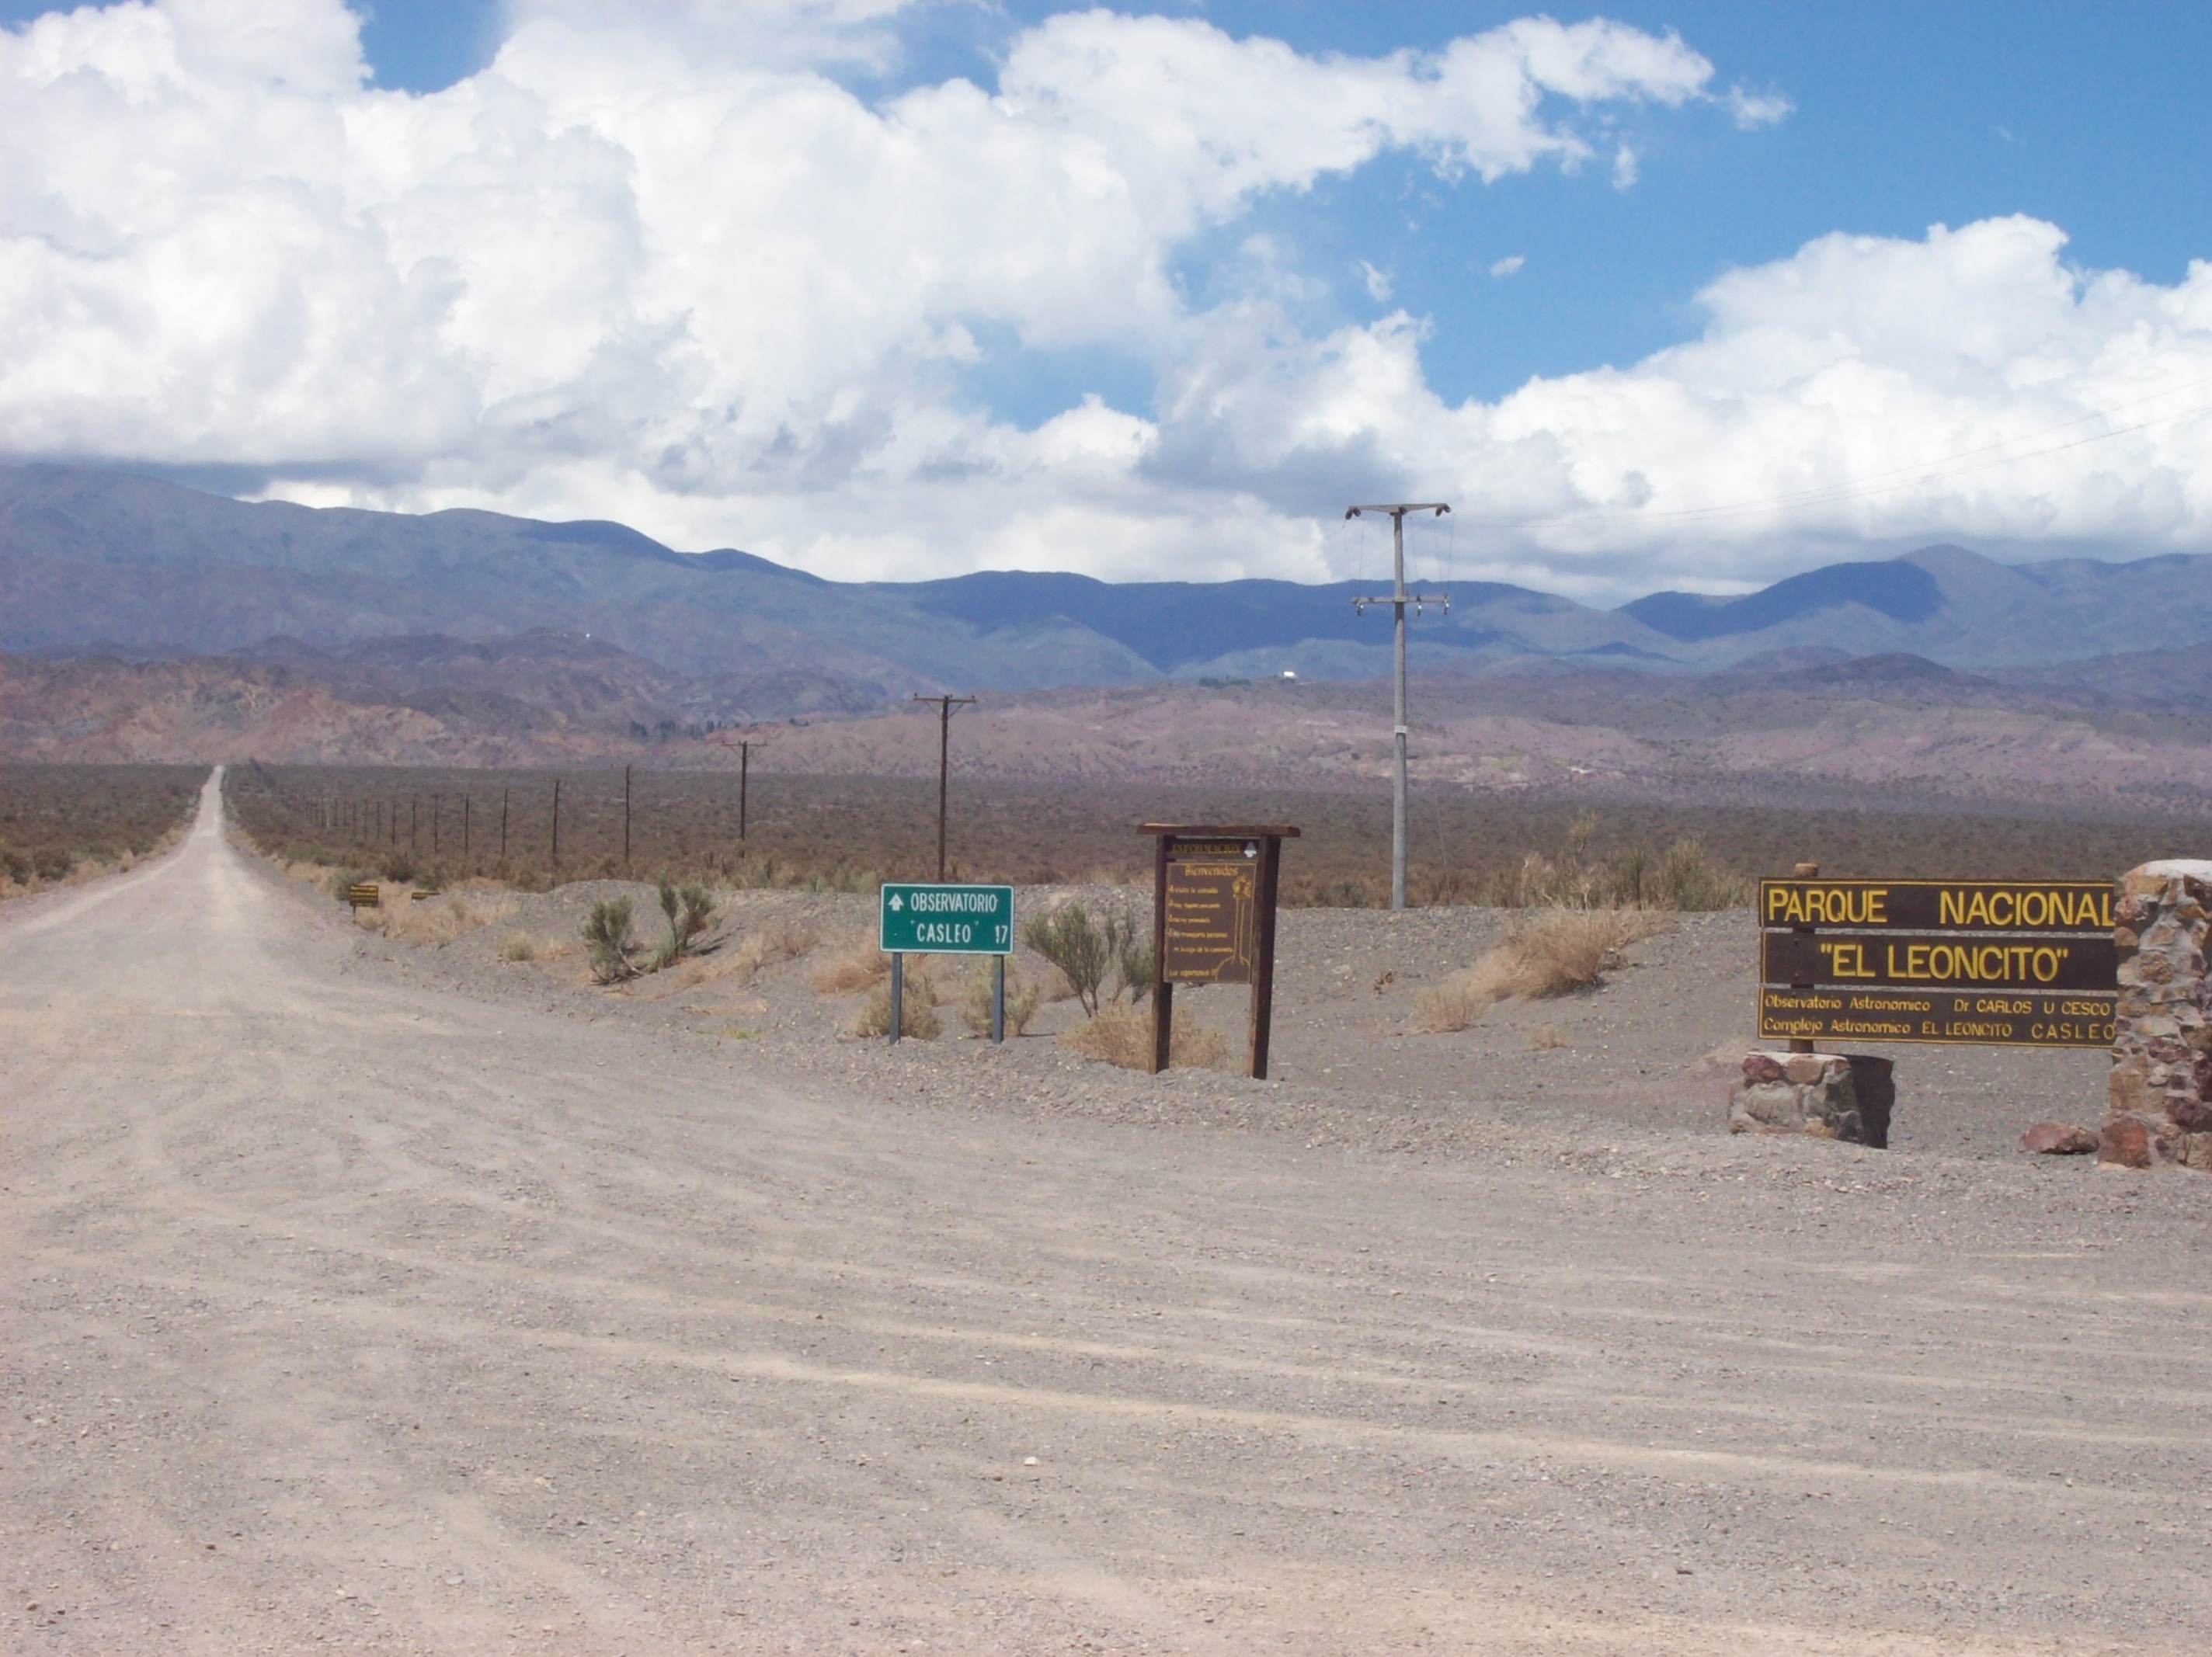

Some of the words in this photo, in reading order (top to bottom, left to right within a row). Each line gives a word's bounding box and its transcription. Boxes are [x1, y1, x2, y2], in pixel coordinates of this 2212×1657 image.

[1185, 863, 1239, 877] Bienvenidos
[910, 892, 997, 912] OBSERVATORIO
[1769, 888, 1888, 923] PARQUE
[1939, 891, 2116, 927] NACIONAL
[994, 925, 1009, 944] 17
[1820, 943, 1876, 978] "EL
[1887, 943, 2069, 982] LEONCITO"
[1764, 995, 1842, 1009] Observatorio
[1849, 995, 1932, 1011] Astronomico
[1976, 999, 2033, 1014] CARLOS
[2043, 1001, 2055, 1015] U
[2061, 1001, 2111, 1016] CESCO
[1763, 1017, 1824, 1035] Complejo
[1830, 1018, 1911, 1034] Astronomico
[1922, 1021, 1939, 1035] EL
[1946, 1023, 2013, 1037] LEONCITO
[2031, 1023, 2116, 1040] CASLEO
